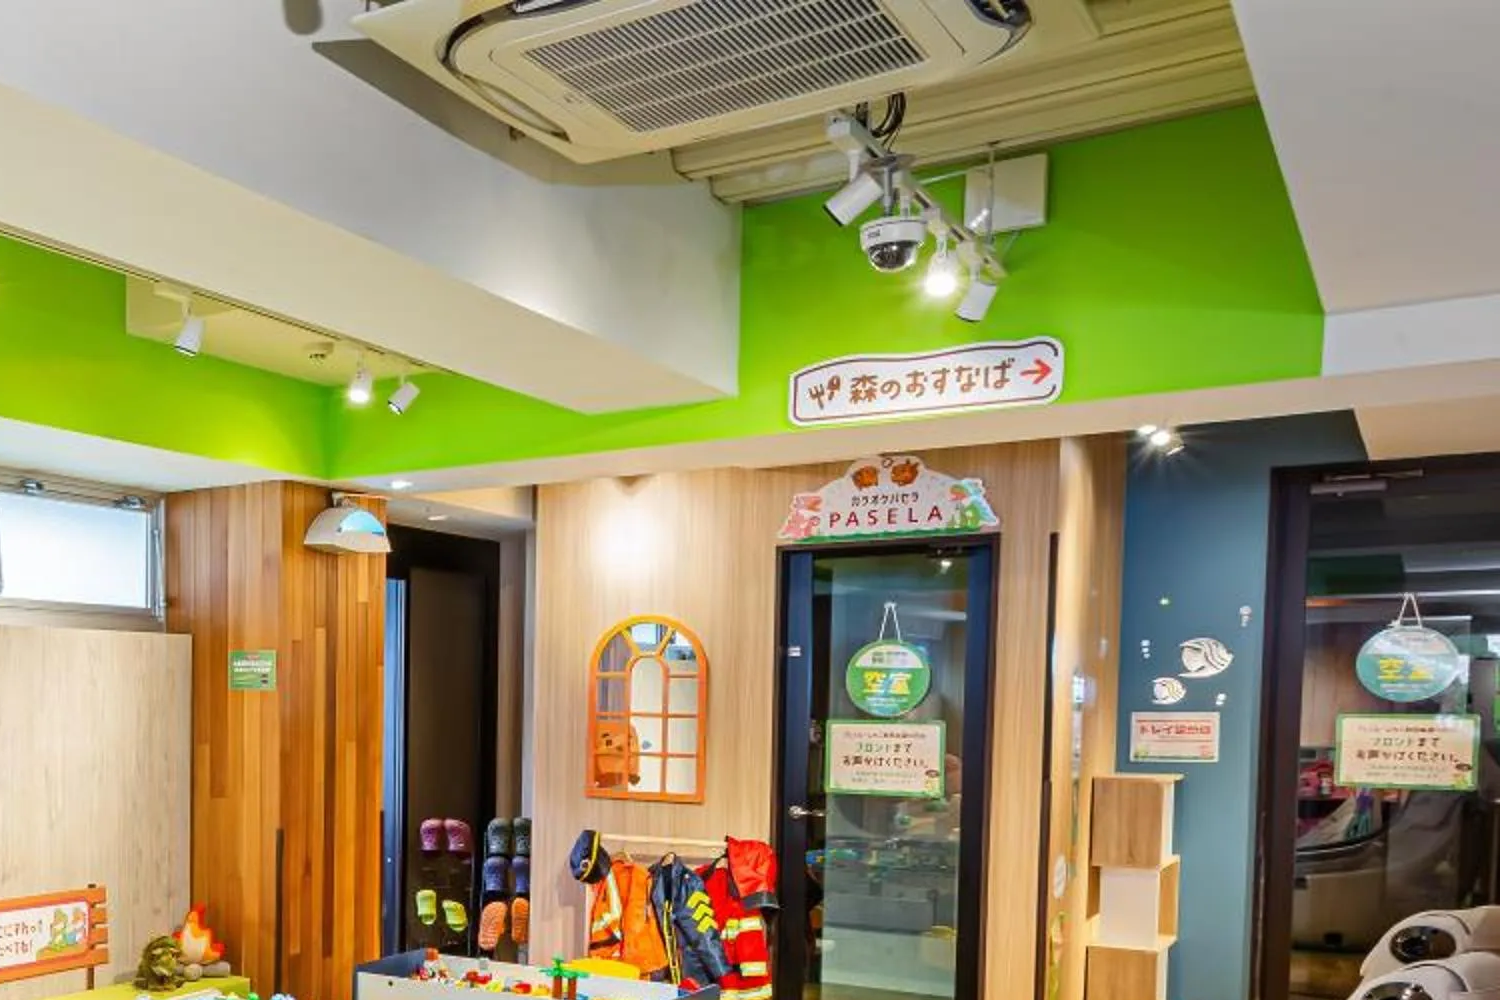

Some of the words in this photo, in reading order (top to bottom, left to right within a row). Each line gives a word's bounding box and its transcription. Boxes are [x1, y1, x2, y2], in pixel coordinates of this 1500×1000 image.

[849, 358, 1016, 404] 森のおすなば
[828, 505, 943, 529] PASELA
